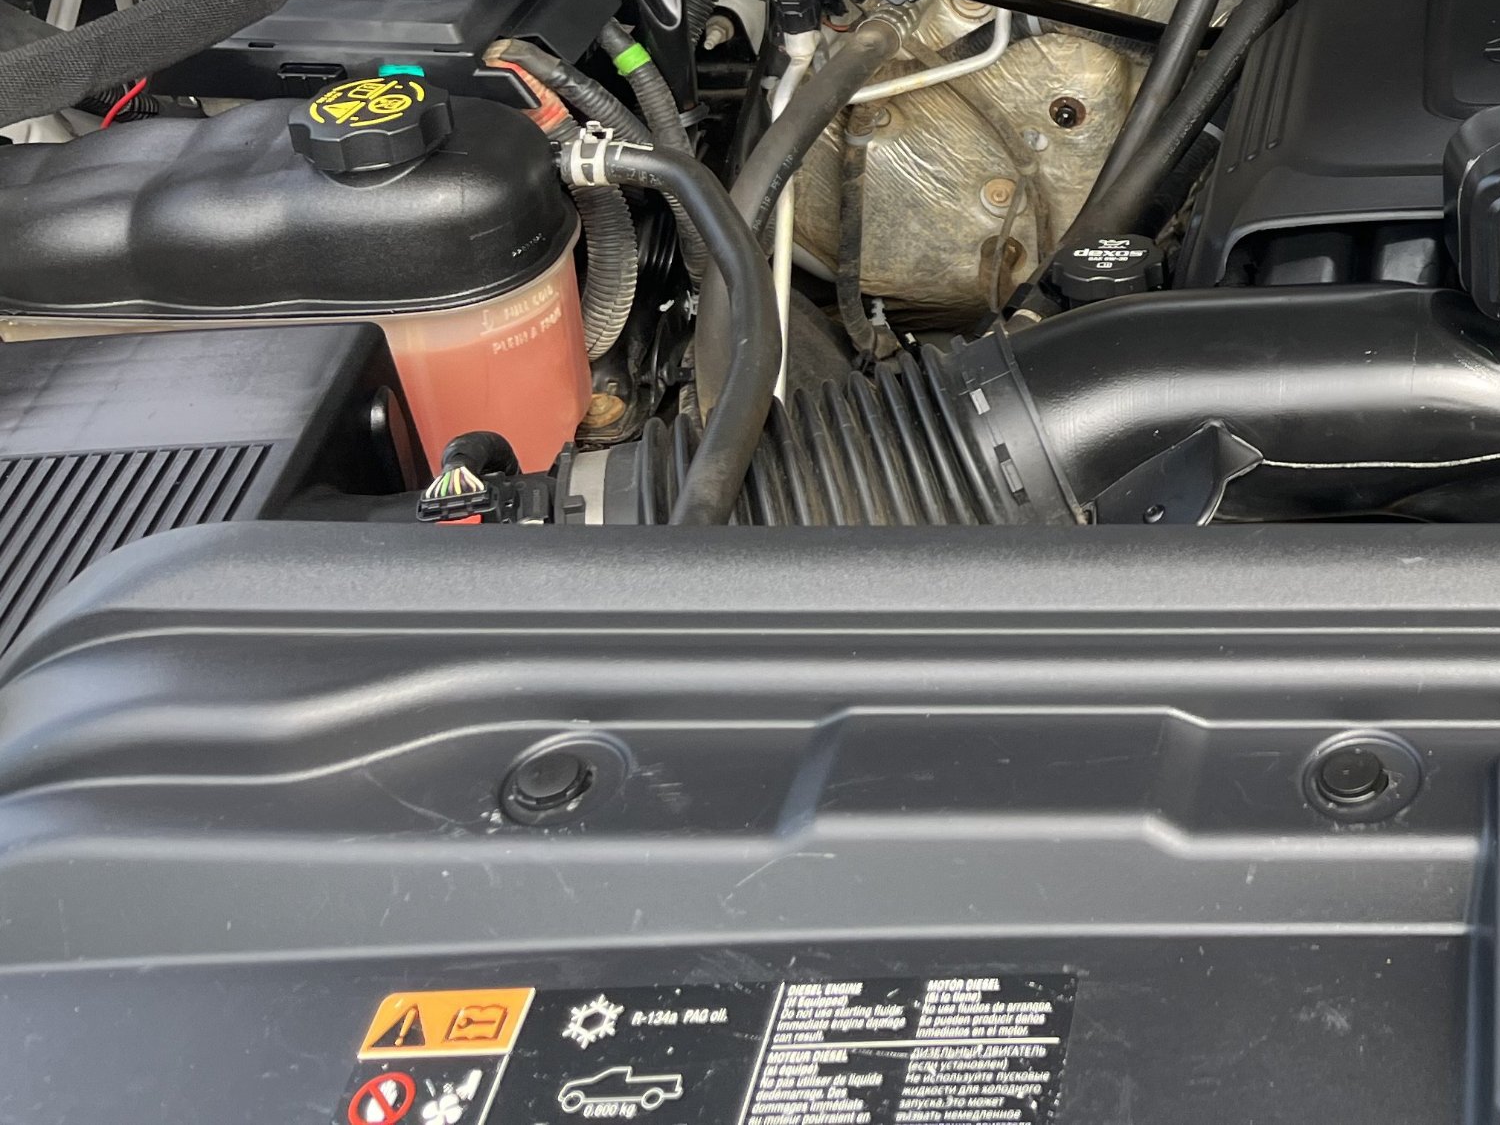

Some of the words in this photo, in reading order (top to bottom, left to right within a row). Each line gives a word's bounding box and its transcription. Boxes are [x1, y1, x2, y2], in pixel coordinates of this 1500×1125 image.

[1073, 248, 1143, 257] dexos
[789, 984, 821, 996] DIESEL
[825, 983, 862, 996] ENGINE
[966, 978, 1001, 991] DIESEL
[782, 1008, 794, 1019] Do
[797, 1008, 811, 1019] not
[816, 1008, 831, 1018] use
[835, 1006, 871, 1019] starting
[939, 1004, 954, 1014] use
[632, 1010, 678, 1025] R-134a
[775, 1033, 790, 1042] can
[768, 1050, 810, 1064] MOTEUR
[813, 1049, 848, 1063] DIESEL
[983, 1044, 1046, 1059] ДВИГАТЕЛЬ
[776, 1077, 793, 1089] pas
[996, 1070, 1051, 1083] пусковые
[903, 1086, 954, 1097] жидкости
[959, 1085, 977, 1096] для
[968, 1097, 1002, 1108] может
